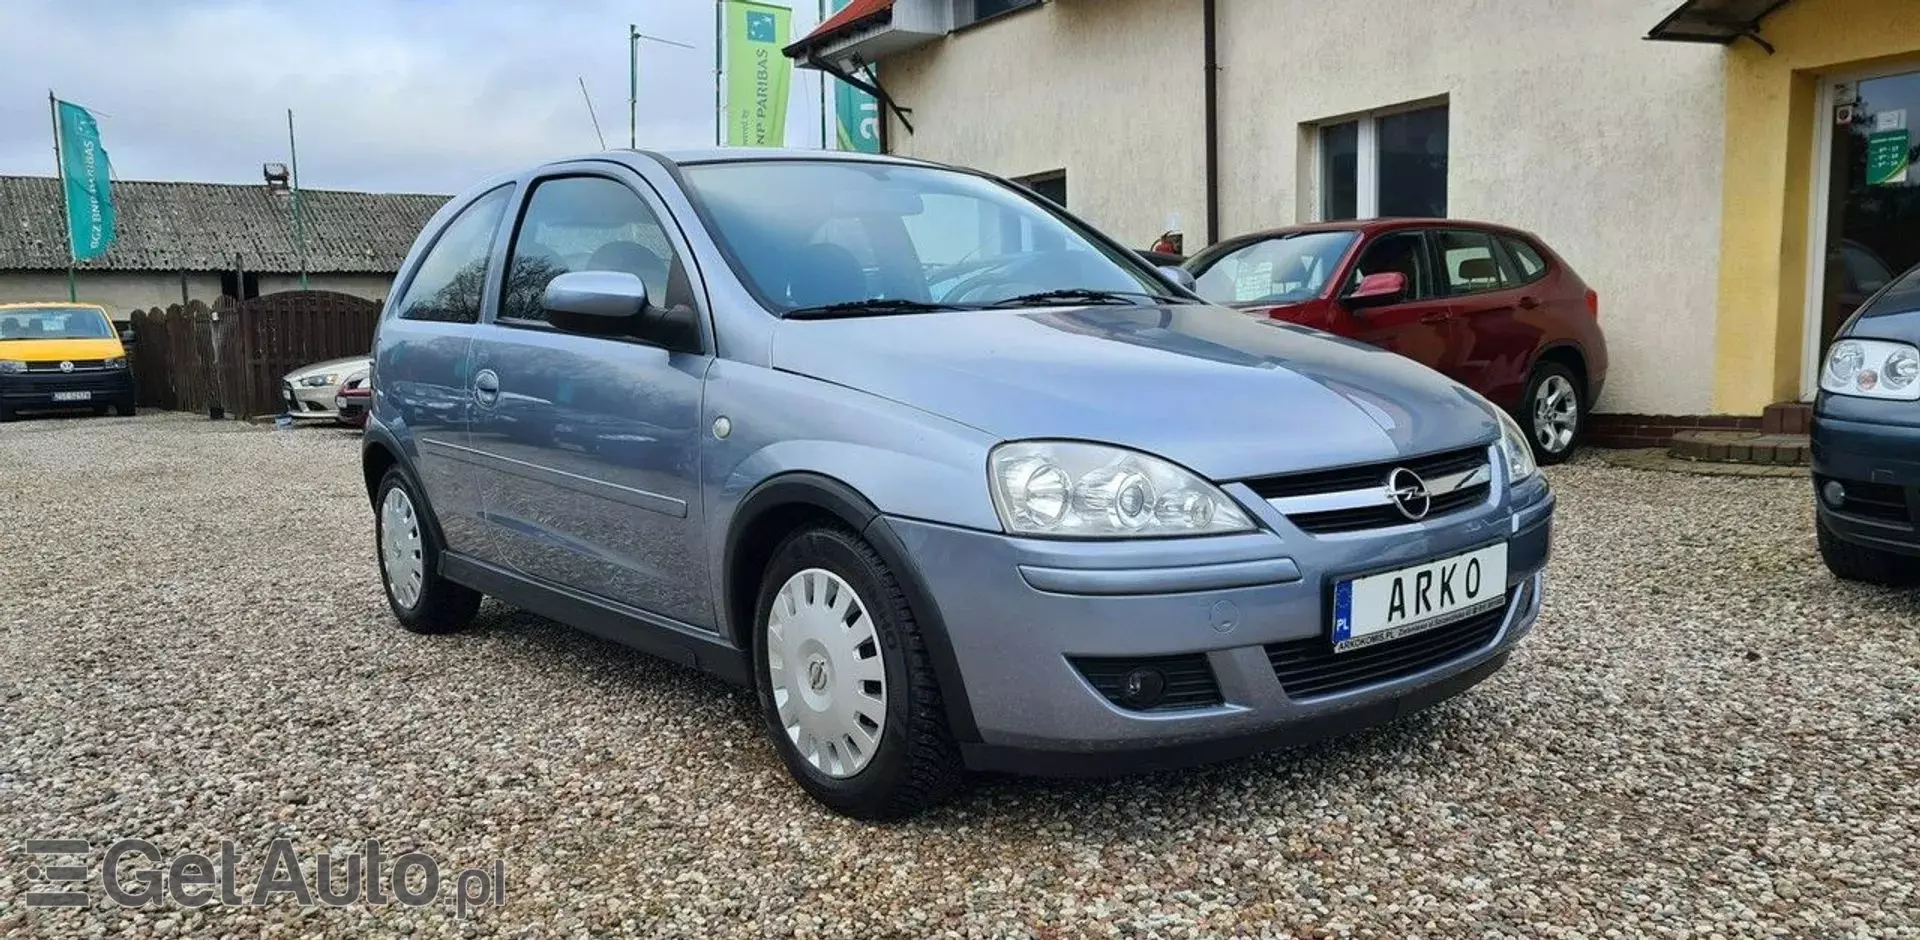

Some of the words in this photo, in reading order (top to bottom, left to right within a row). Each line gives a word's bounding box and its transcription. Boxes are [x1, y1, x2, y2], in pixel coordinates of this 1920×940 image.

[756, 48, 768, 119] PARIBAS
[756, 122, 765, 145] NP
[1388, 558, 1481, 621] ARKO
[1336, 618, 1349, 632] PL
